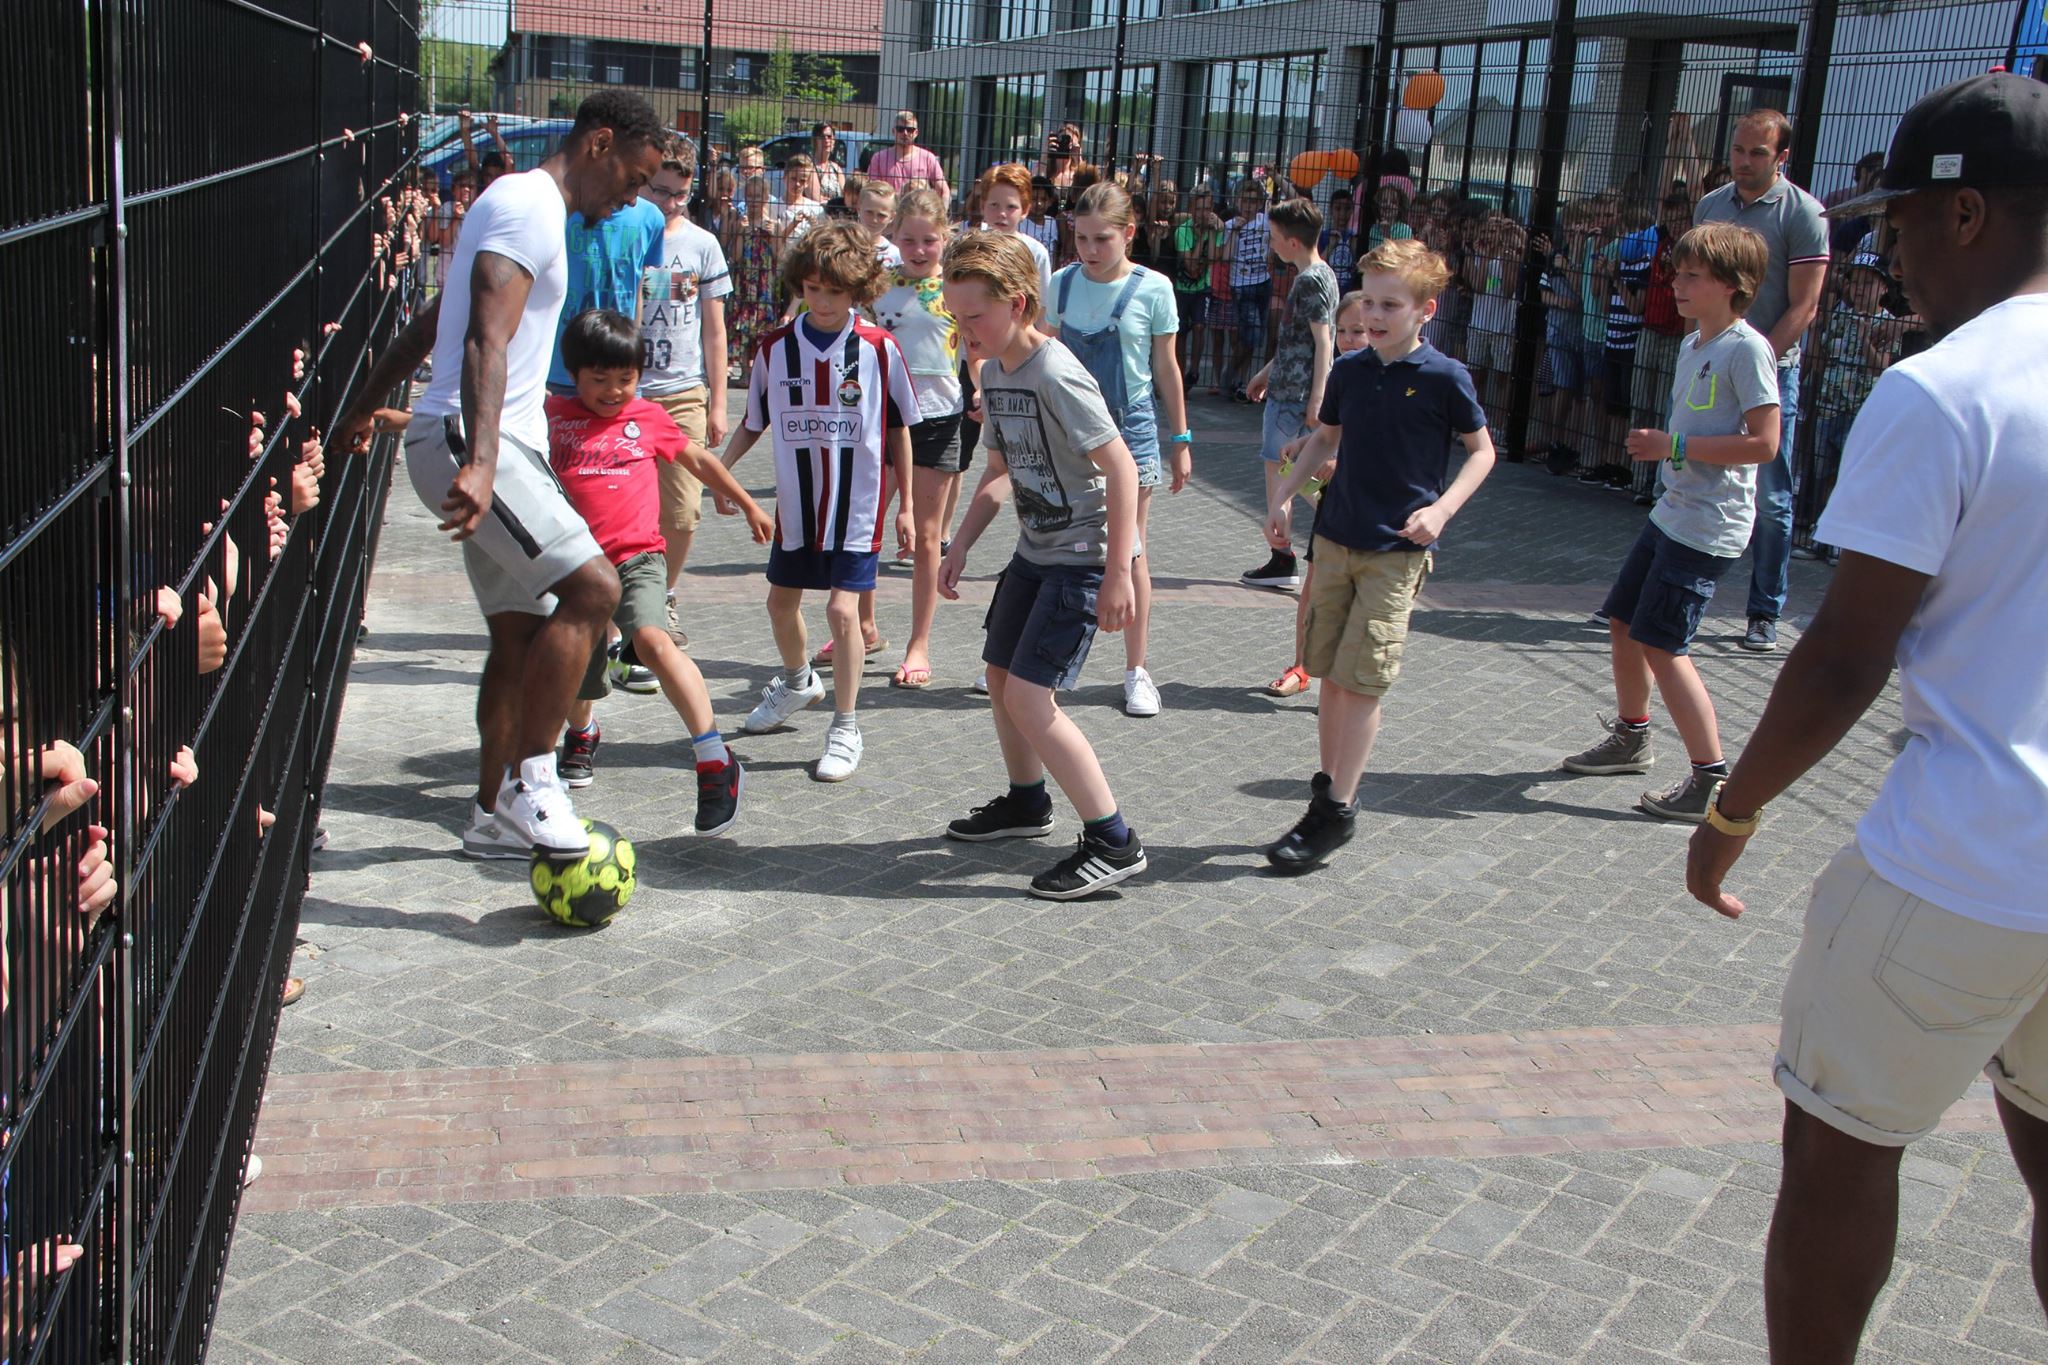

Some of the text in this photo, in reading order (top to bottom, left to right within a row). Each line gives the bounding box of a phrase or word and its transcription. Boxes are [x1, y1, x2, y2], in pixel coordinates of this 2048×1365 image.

[1008, 397, 1031, 414] AWAY
[787, 416, 857, 436] euphony
[1040, 481, 1059, 495] KM
